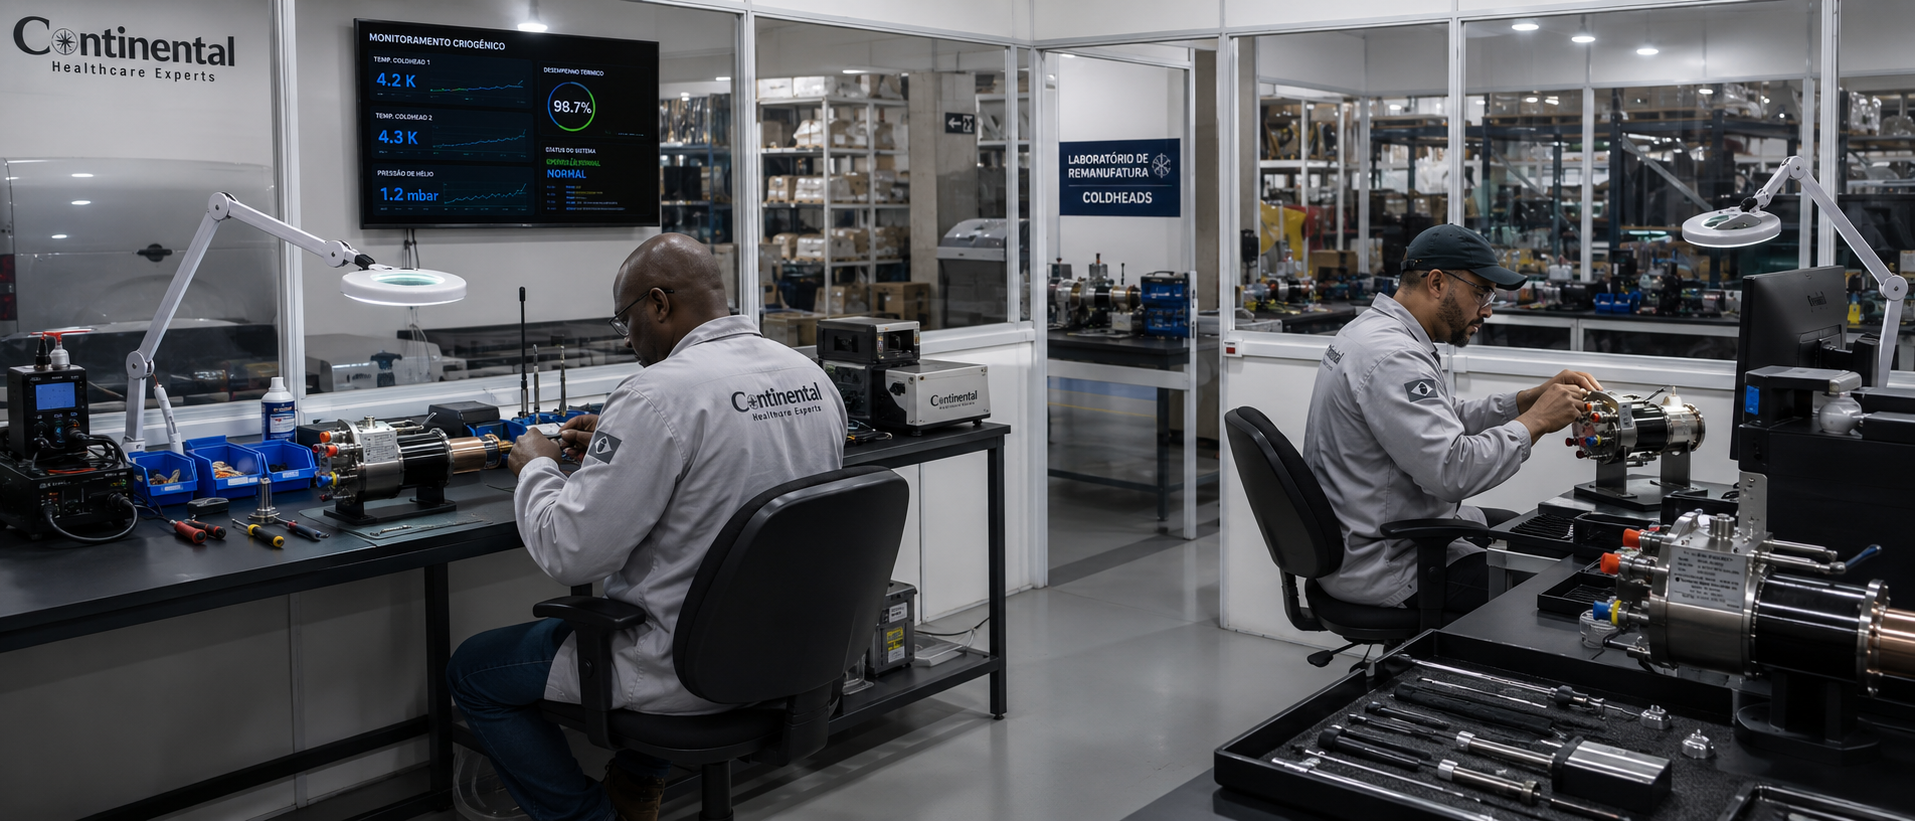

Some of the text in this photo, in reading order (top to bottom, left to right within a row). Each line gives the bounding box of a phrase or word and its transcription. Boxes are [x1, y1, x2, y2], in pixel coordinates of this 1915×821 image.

[13, 16, 235, 67] Continental
[369, 33, 451, 47] MONITORAMENTO
[373, 56, 392, 64] TEMP.
[52, 61, 215, 82] Healthcare Experts
[376, 72, 417, 88] 4.2 K
[553, 100, 592, 114] 98.7%
[375, 112, 394, 120] TEMP.
[378, 129, 418, 145] 4.3 K
[1068, 151, 1149, 165] LABORATÓRIO DE
[1068, 167, 1149, 178] REMANUFATURA
[380, 187, 439, 202] 1.2 mbar
[1082, 191, 1153, 204] COLDHEADS
[731, 382, 823, 413] Continental
[930, 390, 978, 407] Continental
[794, 405, 822, 416] Experts
